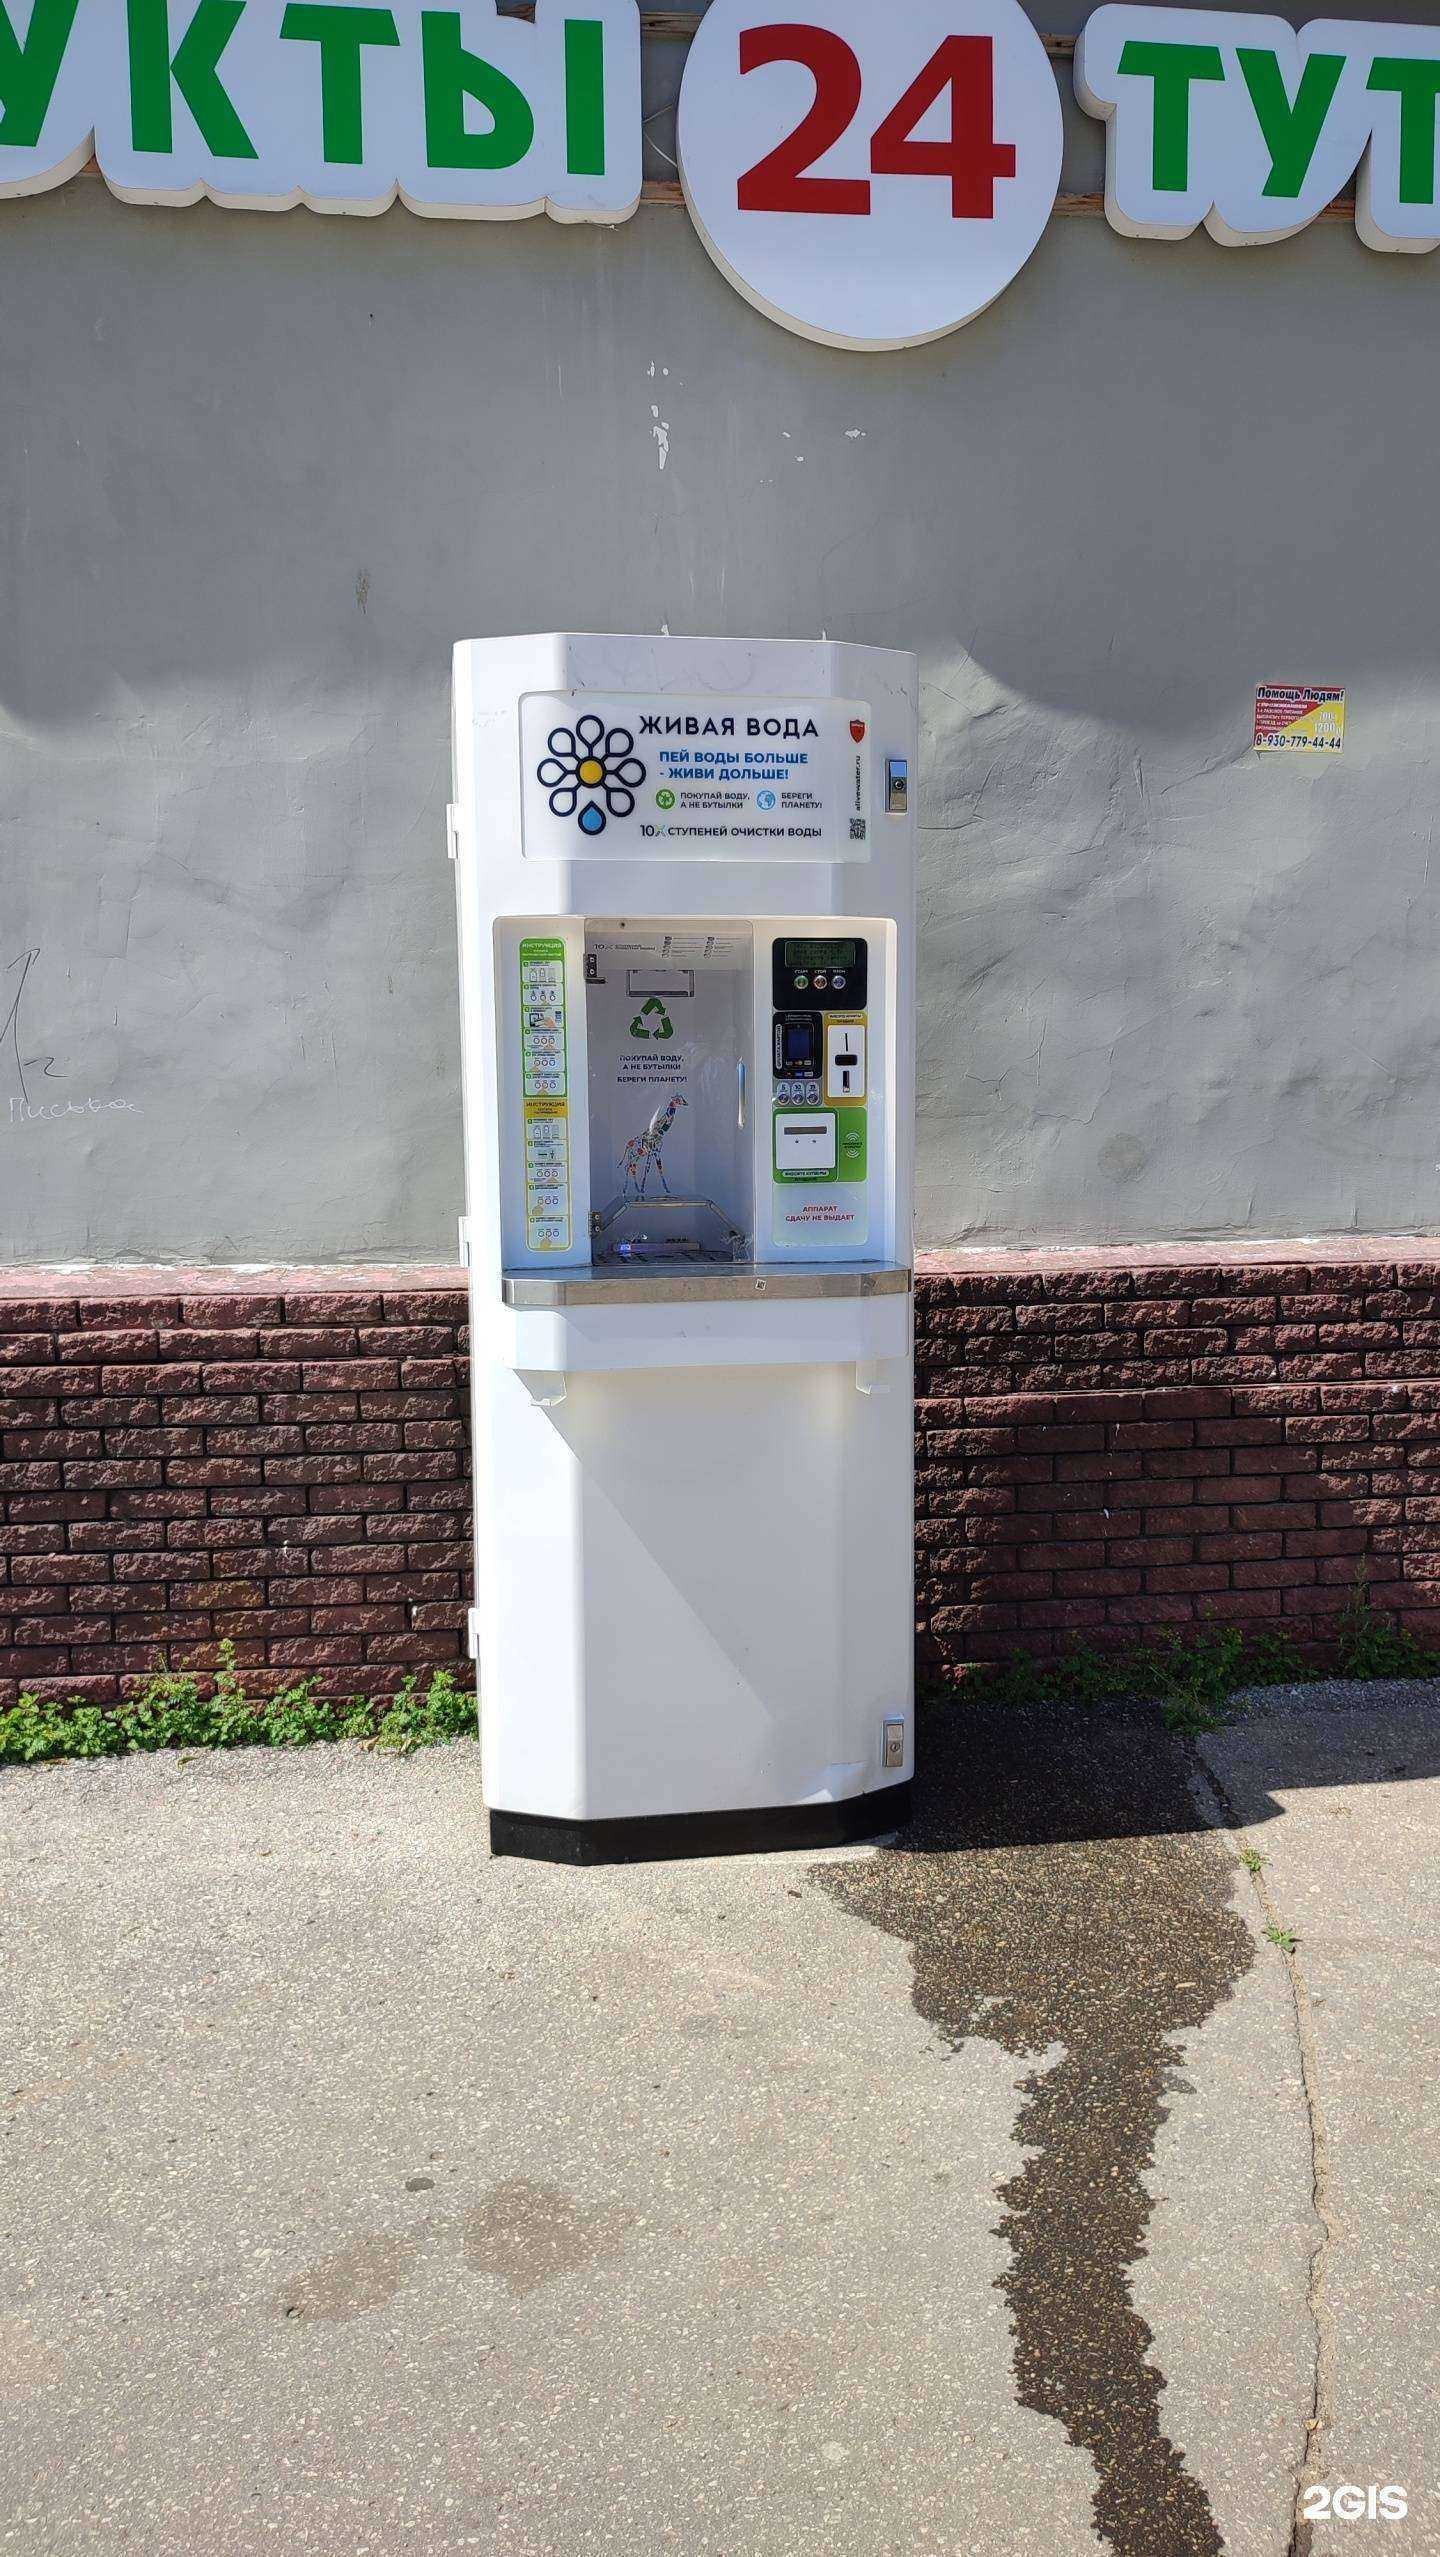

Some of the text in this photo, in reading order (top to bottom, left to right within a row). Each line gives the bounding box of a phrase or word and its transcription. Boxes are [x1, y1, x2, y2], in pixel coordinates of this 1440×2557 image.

[737, 23, 1016, 219] 24
[1258, 687, 1344, 703] Помощь Людям!
[639, 716, 819, 740] ЖИВАЯ ВОДА
[1256, 734, 1341, 749] 8-930-779-44-44
[659, 749, 808, 765] ПЕЙ ВОДЫ БОЛЬШЕ
[668, 767, 715, 779] ЖИВИ
[719, 768, 789, 781] ДОЛЬШЕ!
[680, 791, 750, 801] ПОКУПАЙ ВОДУ,
[781, 792, 813, 800] БЕРЕГИ
[702, 802, 743, 810] БУТЫЛКИ
[668, 826, 728, 837] СТУПЕНЕЙ
[731, 827, 785, 837] ОЧИСТКИ
[788, 828, 822, 838] ВОДЫ
